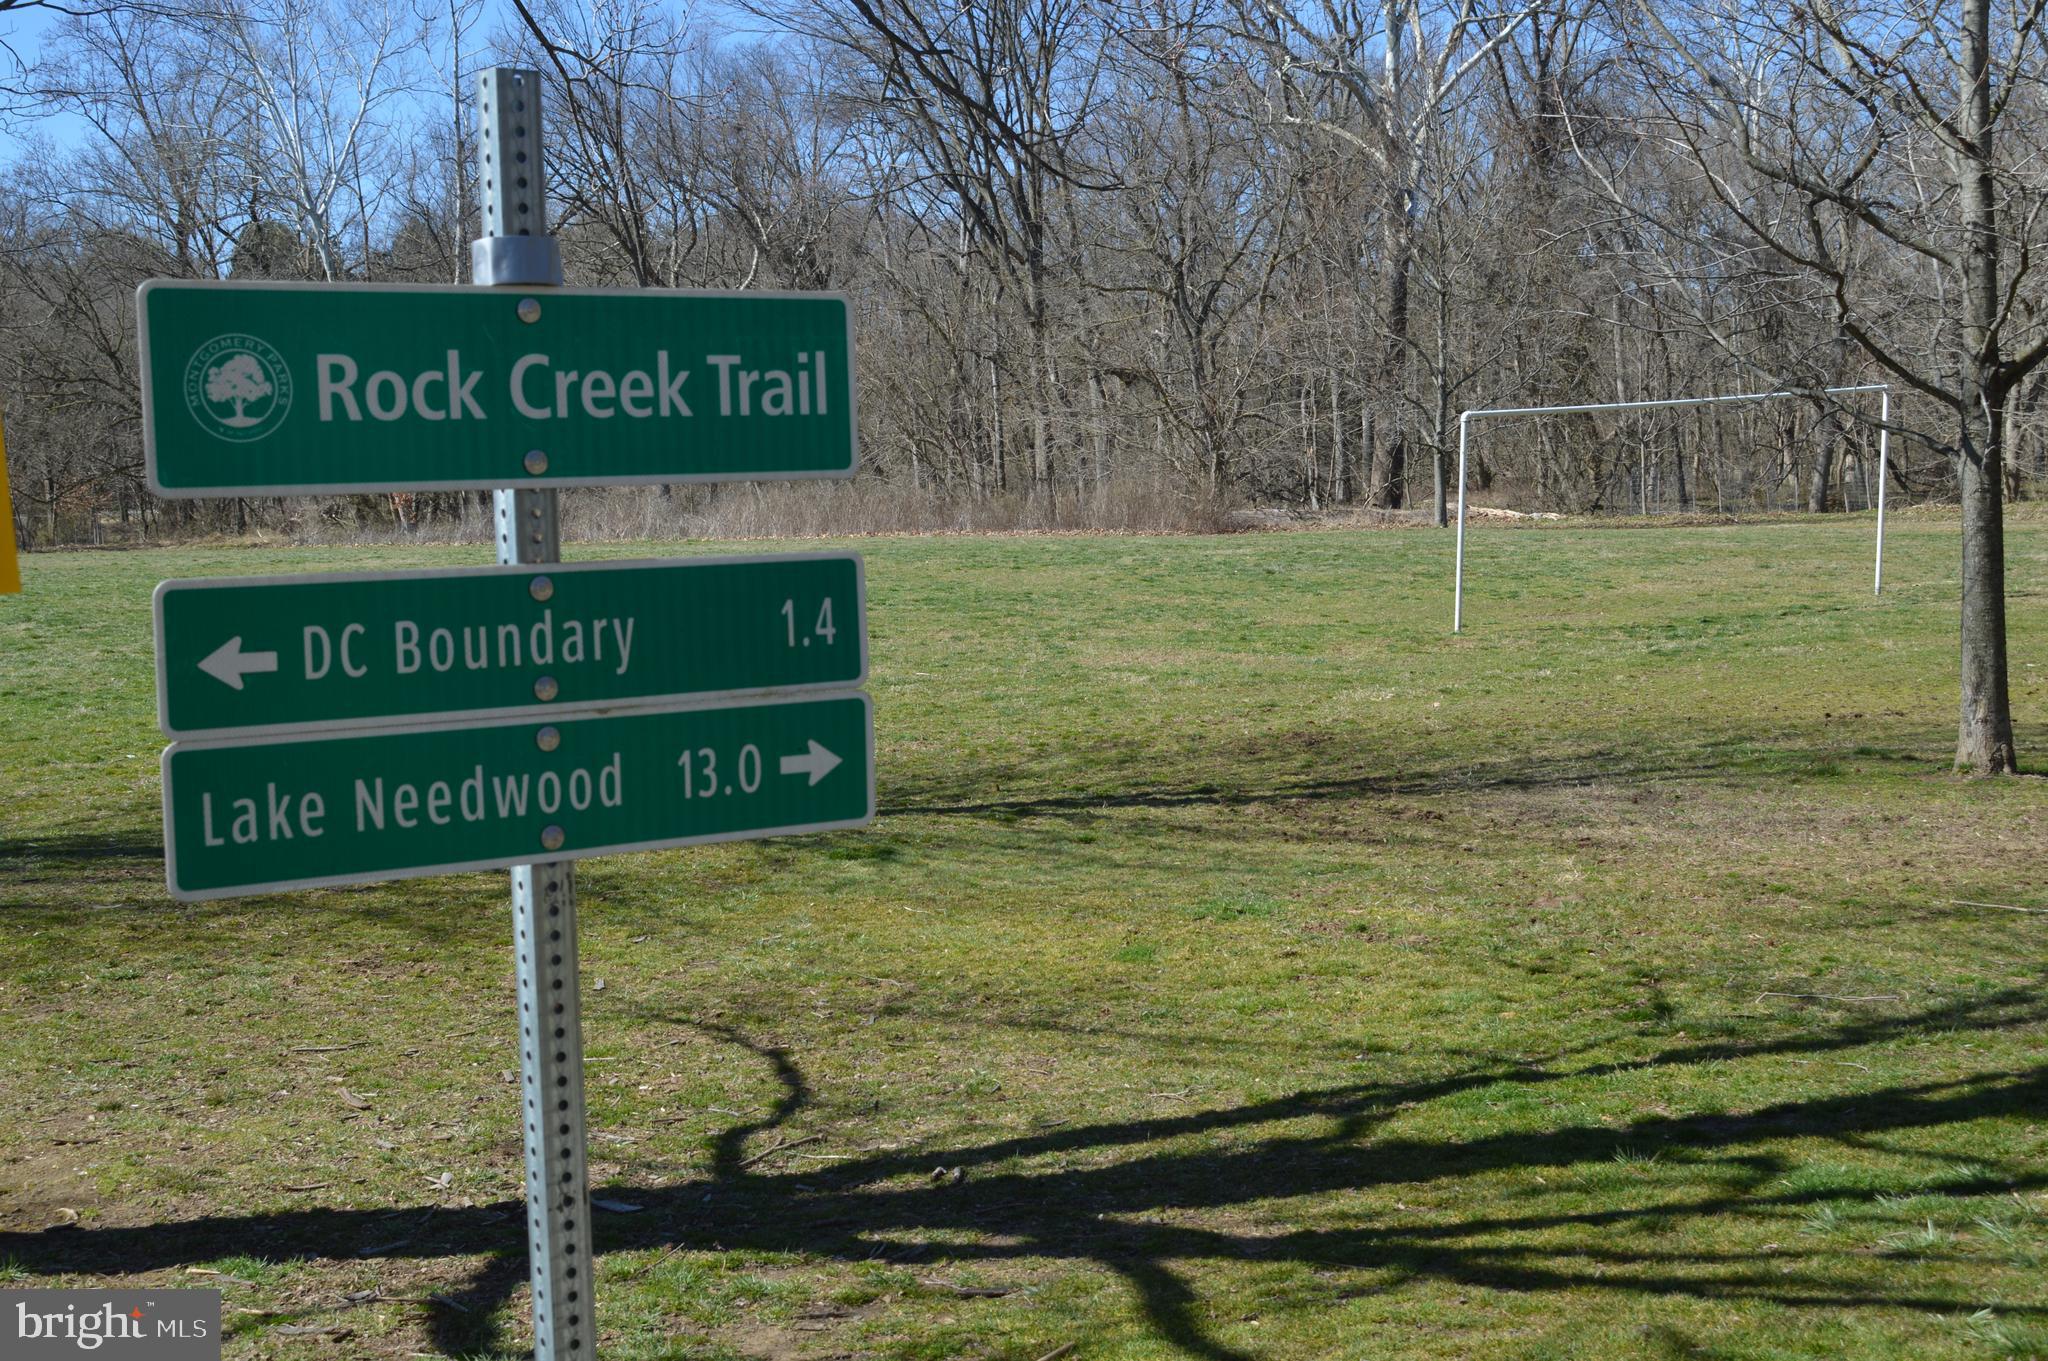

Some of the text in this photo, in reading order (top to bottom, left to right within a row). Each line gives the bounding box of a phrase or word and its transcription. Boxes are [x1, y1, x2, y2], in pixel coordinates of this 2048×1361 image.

[187, 337, 290, 407] MONTGOMERY PARKS
[317, 349, 828, 421] Rock Creek Trail
[303, 596, 837, 680] DC Boundary 1.4
[202, 743, 763, 847] Lake Needwood 13.0
